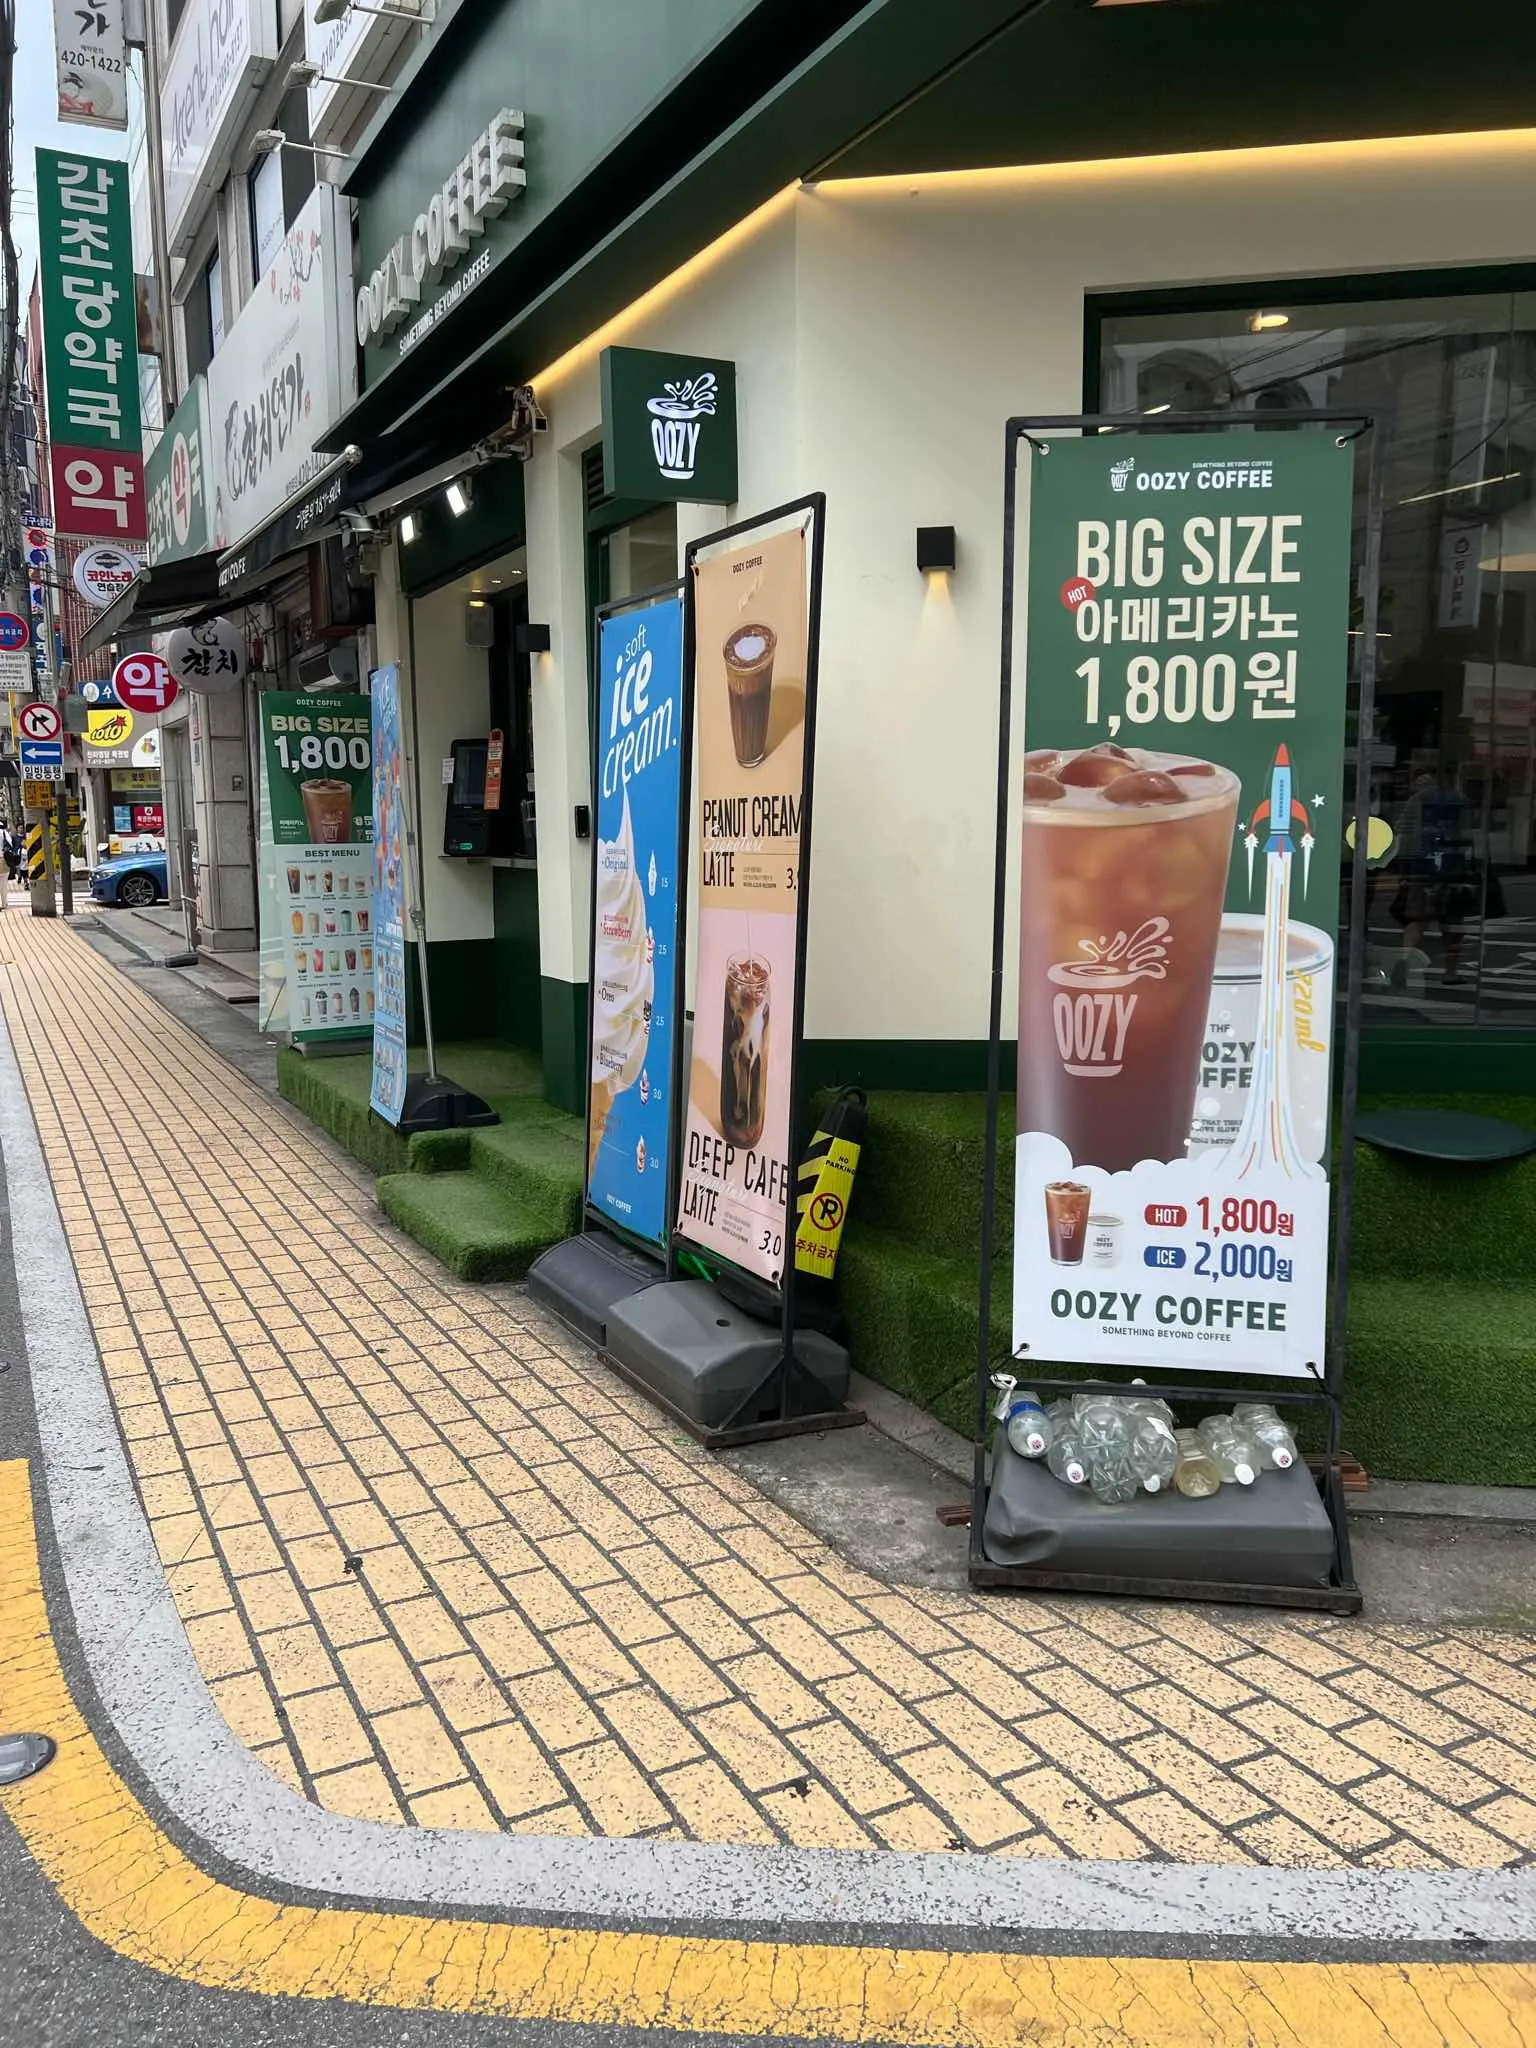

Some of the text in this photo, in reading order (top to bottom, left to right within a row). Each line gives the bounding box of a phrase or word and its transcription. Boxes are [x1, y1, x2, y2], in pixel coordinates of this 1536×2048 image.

[61, 50, 121, 73] 420-1422
[356, 107, 527, 347] OOZY COFFEE
[57, 161, 124, 440] 감초당약국
[399, 247, 491, 357] SOMETHING BEYOND COFFEE
[651, 418, 701, 469] OOZY
[64, 459, 135, 529] 약
[1110, 474, 1129, 489] OOZY
[1136, 470, 1273, 491] OOZY COFFEE
[732, 555, 763, 574] OOZY COFFEE
[1076, 515, 1302, 588] BIG SIZE
[87, 570, 133, 582] 코인노래
[1067, 585, 1088, 605] HOT
[1076, 595, 1299, 644] 아메리카노
[625, 623, 648, 662] soft
[181, 648, 238, 676] 참치
[122, 662, 170, 706] 약
[610, 650, 653, 740] ice
[1075, 650, 1298, 737] 1,800원
[296, 698, 342, 707] OOZY COFFEE
[271, 715, 370, 734] BIG SIZE
[274, 735, 371, 774] 1,800
[603, 696, 677, 799] cream.
[24, 766, 61, 779] 일방통행
[703, 794, 803, 838] PEANUT CREAM
[305, 849, 360, 858] BEST MENU
[605, 857, 629, 873] Original
[703, 851, 735, 888] LATTE
[786, 867, 797, 890] 3.
[1052, 992, 1138, 1062] OOZY
[1201, 1041, 1256, 1063] OZY
[688, 1131, 735, 1181] DEEP
[744, 1150, 789, 1207] CAFE
[825, 1159, 857, 1176] PARKING
[839, 1155, 849, 1164] NO
[615, 1199, 632, 1214] COFFEE
[683, 1180, 720, 1227] LATTE
[1155, 1208, 1180, 1224] HOT
[758, 1230, 782, 1257] 3.0
[795, 1238, 835, 1261] 주차금지
[1156, 1249, 1176, 1265] ICE
[1050, 1287, 1287, 1332] OOZY COFFEE
[1102, 1325, 1232, 1343] SOMETHING BEYOND COFFEE
